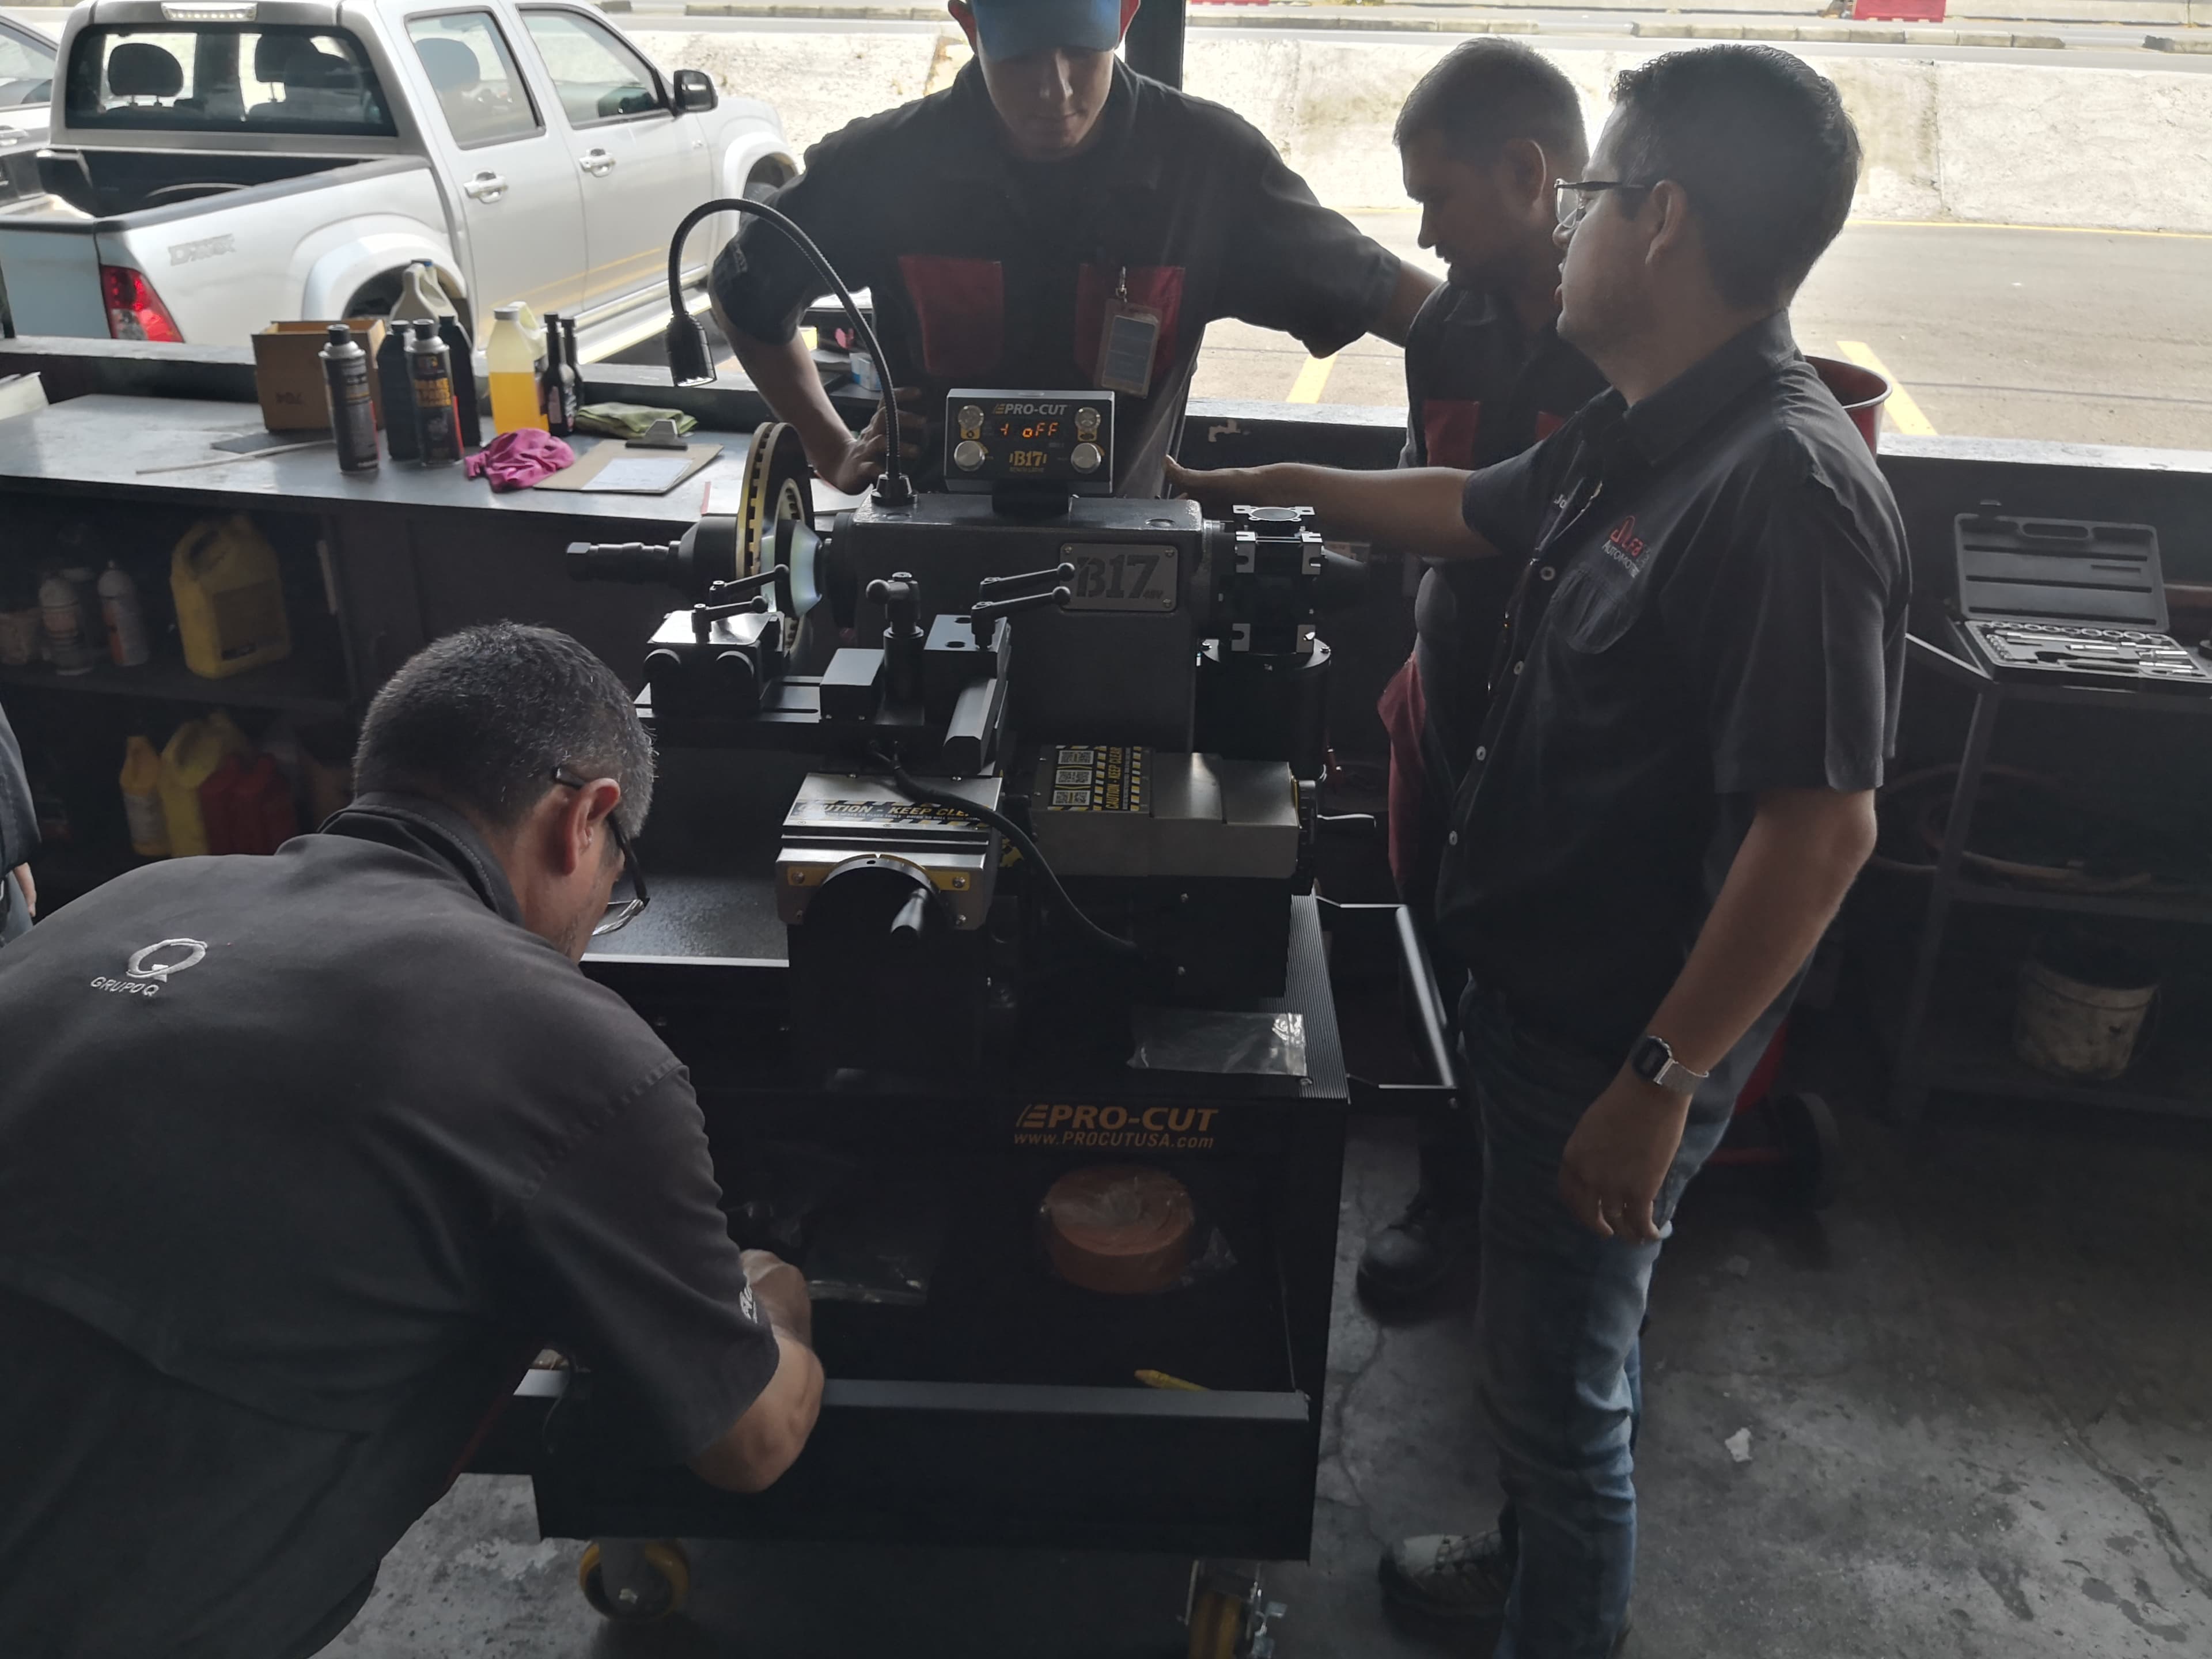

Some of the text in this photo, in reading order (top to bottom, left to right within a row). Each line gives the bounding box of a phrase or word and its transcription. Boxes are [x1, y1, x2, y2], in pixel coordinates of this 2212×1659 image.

[1005, 404, 1067, 415] PRO-CUT
[1013, 450, 1043, 467] B17
[1076, 554, 1160, 599] B17
[798, 803, 873, 813] CUTION
[888, 806, 933, 815] KEEP
[936, 808, 969, 817] CLE
[1047, 1104, 1219, 1132] PRO-CUT
[1014, 1130, 1214, 1149] www.PROCUTUSA.com
